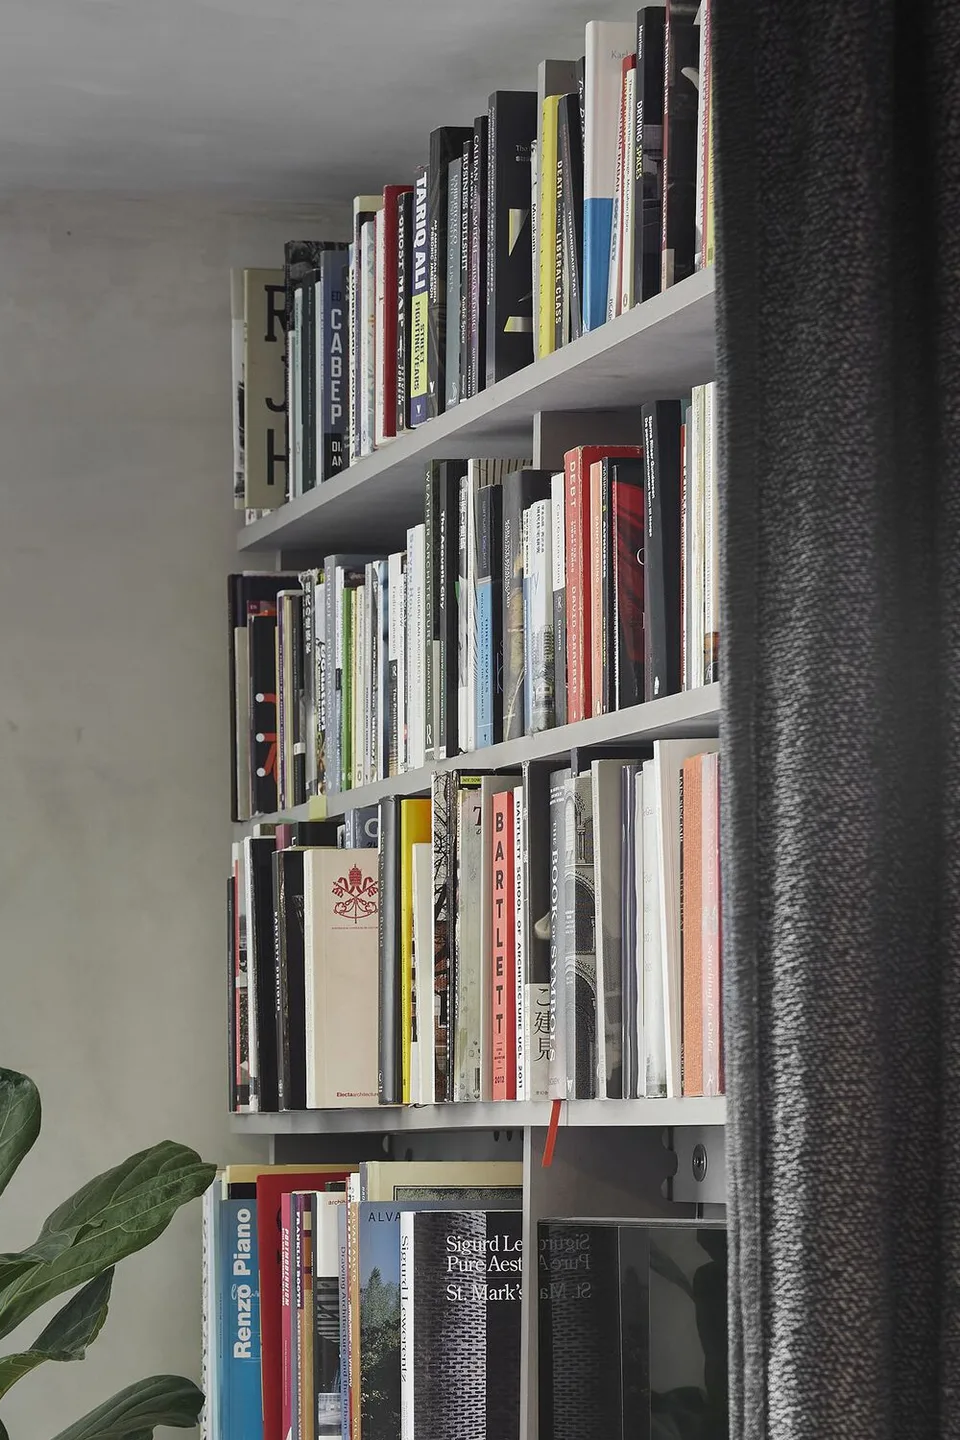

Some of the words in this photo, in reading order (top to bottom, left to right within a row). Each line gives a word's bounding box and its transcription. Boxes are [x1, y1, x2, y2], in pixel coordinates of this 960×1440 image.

[413, 171, 427, 248] TARIQ
[414, 252, 426, 291] ALI
[555, 232, 563, 283] LIBERAL
[551, 848, 559, 921] BOOK
[494, 812, 505, 1034] BARTLETT
[516, 920, 522, 936] OF
[549, 944, 558, 1062] SYMBOLS
[494, 1075, 505, 1084] 2012
[233, 1207, 252, 1276] Piano
[401, 1234, 409, 1290] Sigurd
[446, 1234, 500, 1255] Sigurd
[446, 1255, 485, 1272] Pure
[339, 1246, 347, 1291] Drawing
[446, 1283, 467, 1301] St.
[233, 1284, 252, 1359] Renzo
[401, 1295, 409, 1383] Lewerentz
